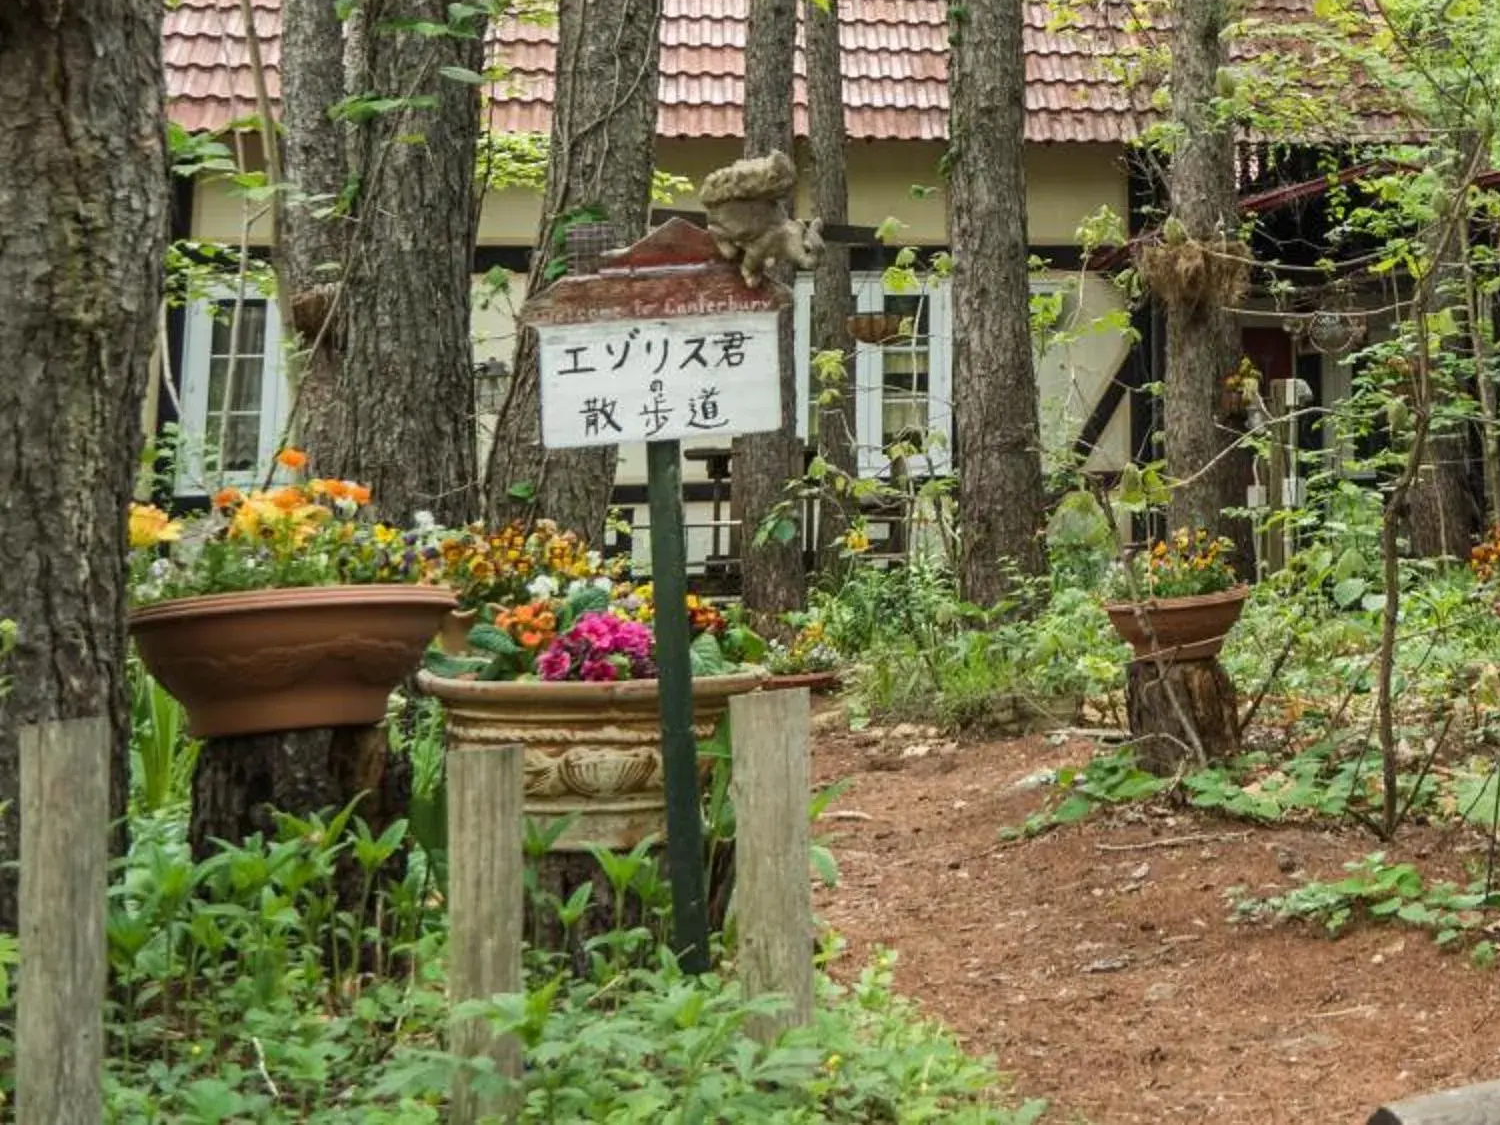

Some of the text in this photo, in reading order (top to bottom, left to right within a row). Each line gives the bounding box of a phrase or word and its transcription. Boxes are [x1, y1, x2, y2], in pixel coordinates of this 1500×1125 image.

[557, 327, 755, 376] エゾリス君
[578, 386, 730, 437] 散歩道
